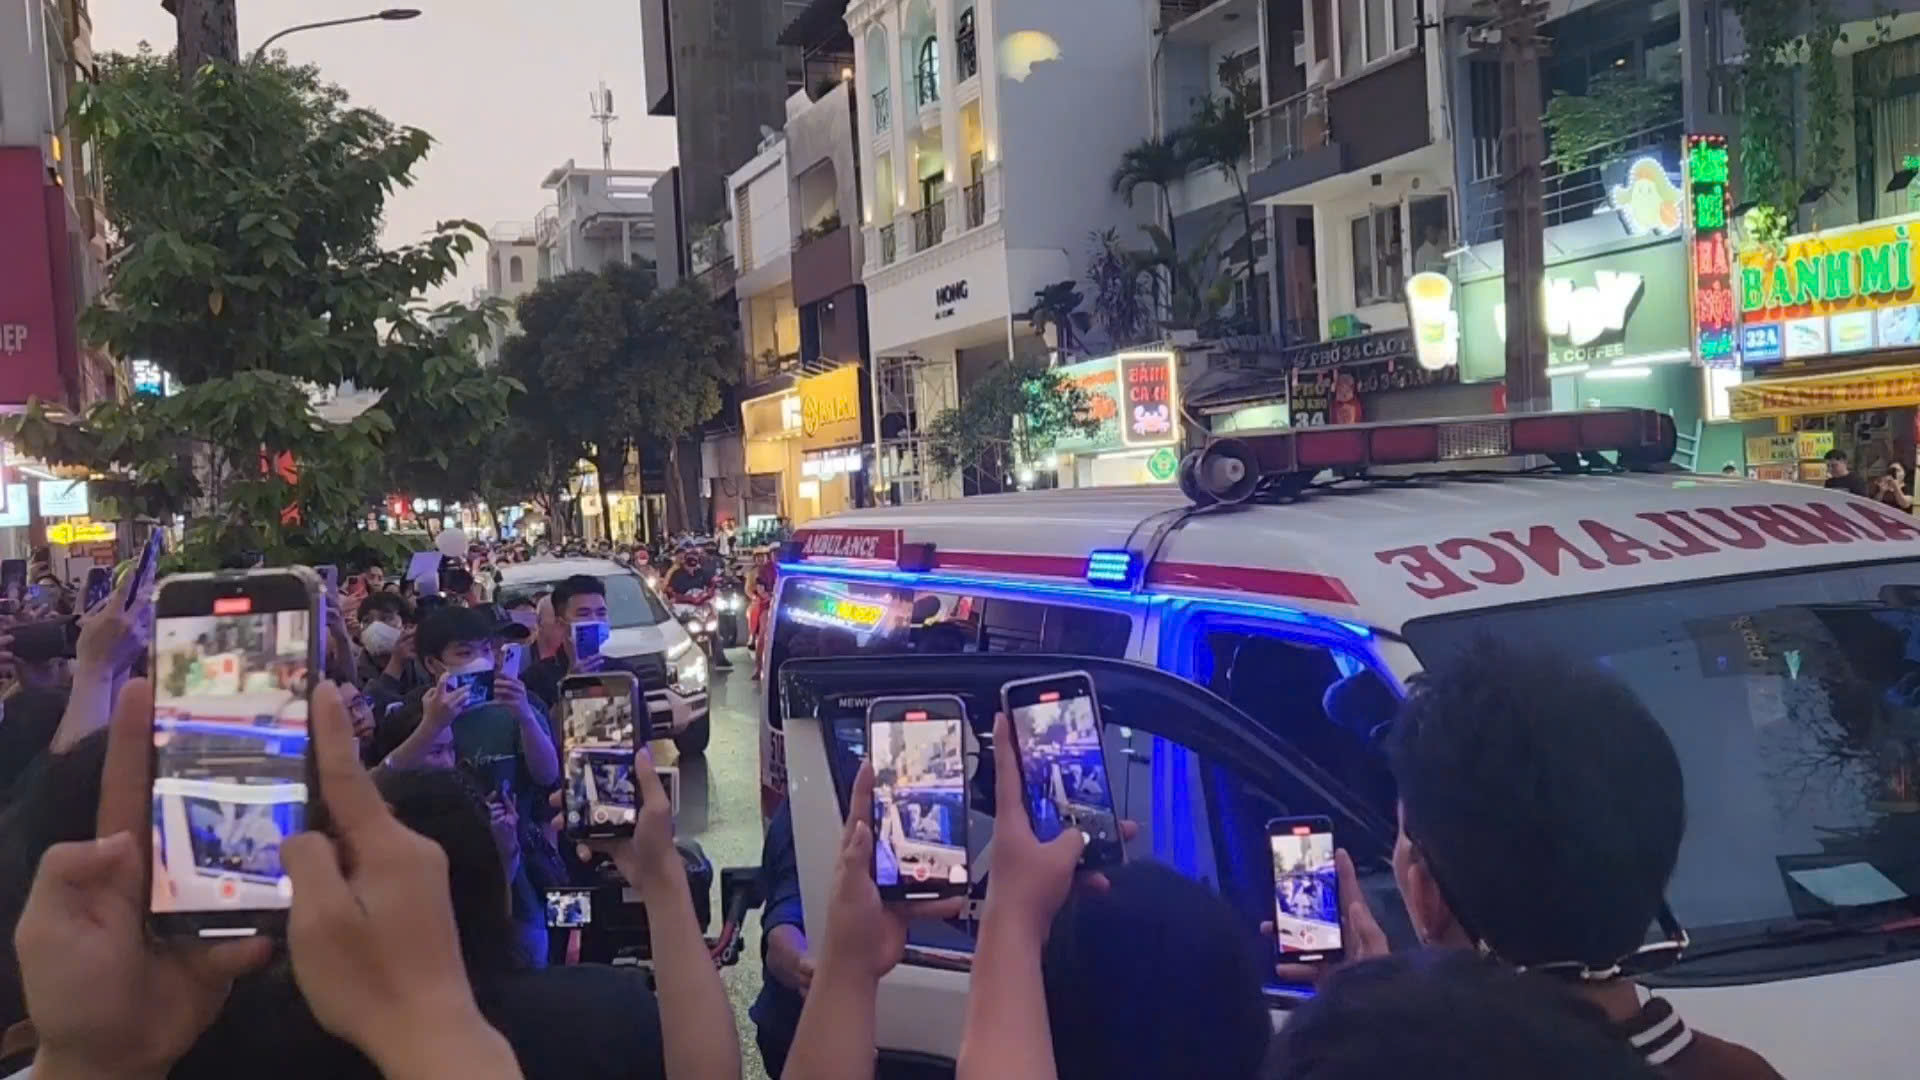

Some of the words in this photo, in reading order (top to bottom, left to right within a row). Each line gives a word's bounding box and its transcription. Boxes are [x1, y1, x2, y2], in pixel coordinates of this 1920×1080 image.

[0, 325, 27, 356] ẸP
[1746, 329, 1777, 349] 32A
[802, 533, 880, 557] AMBULANCE
